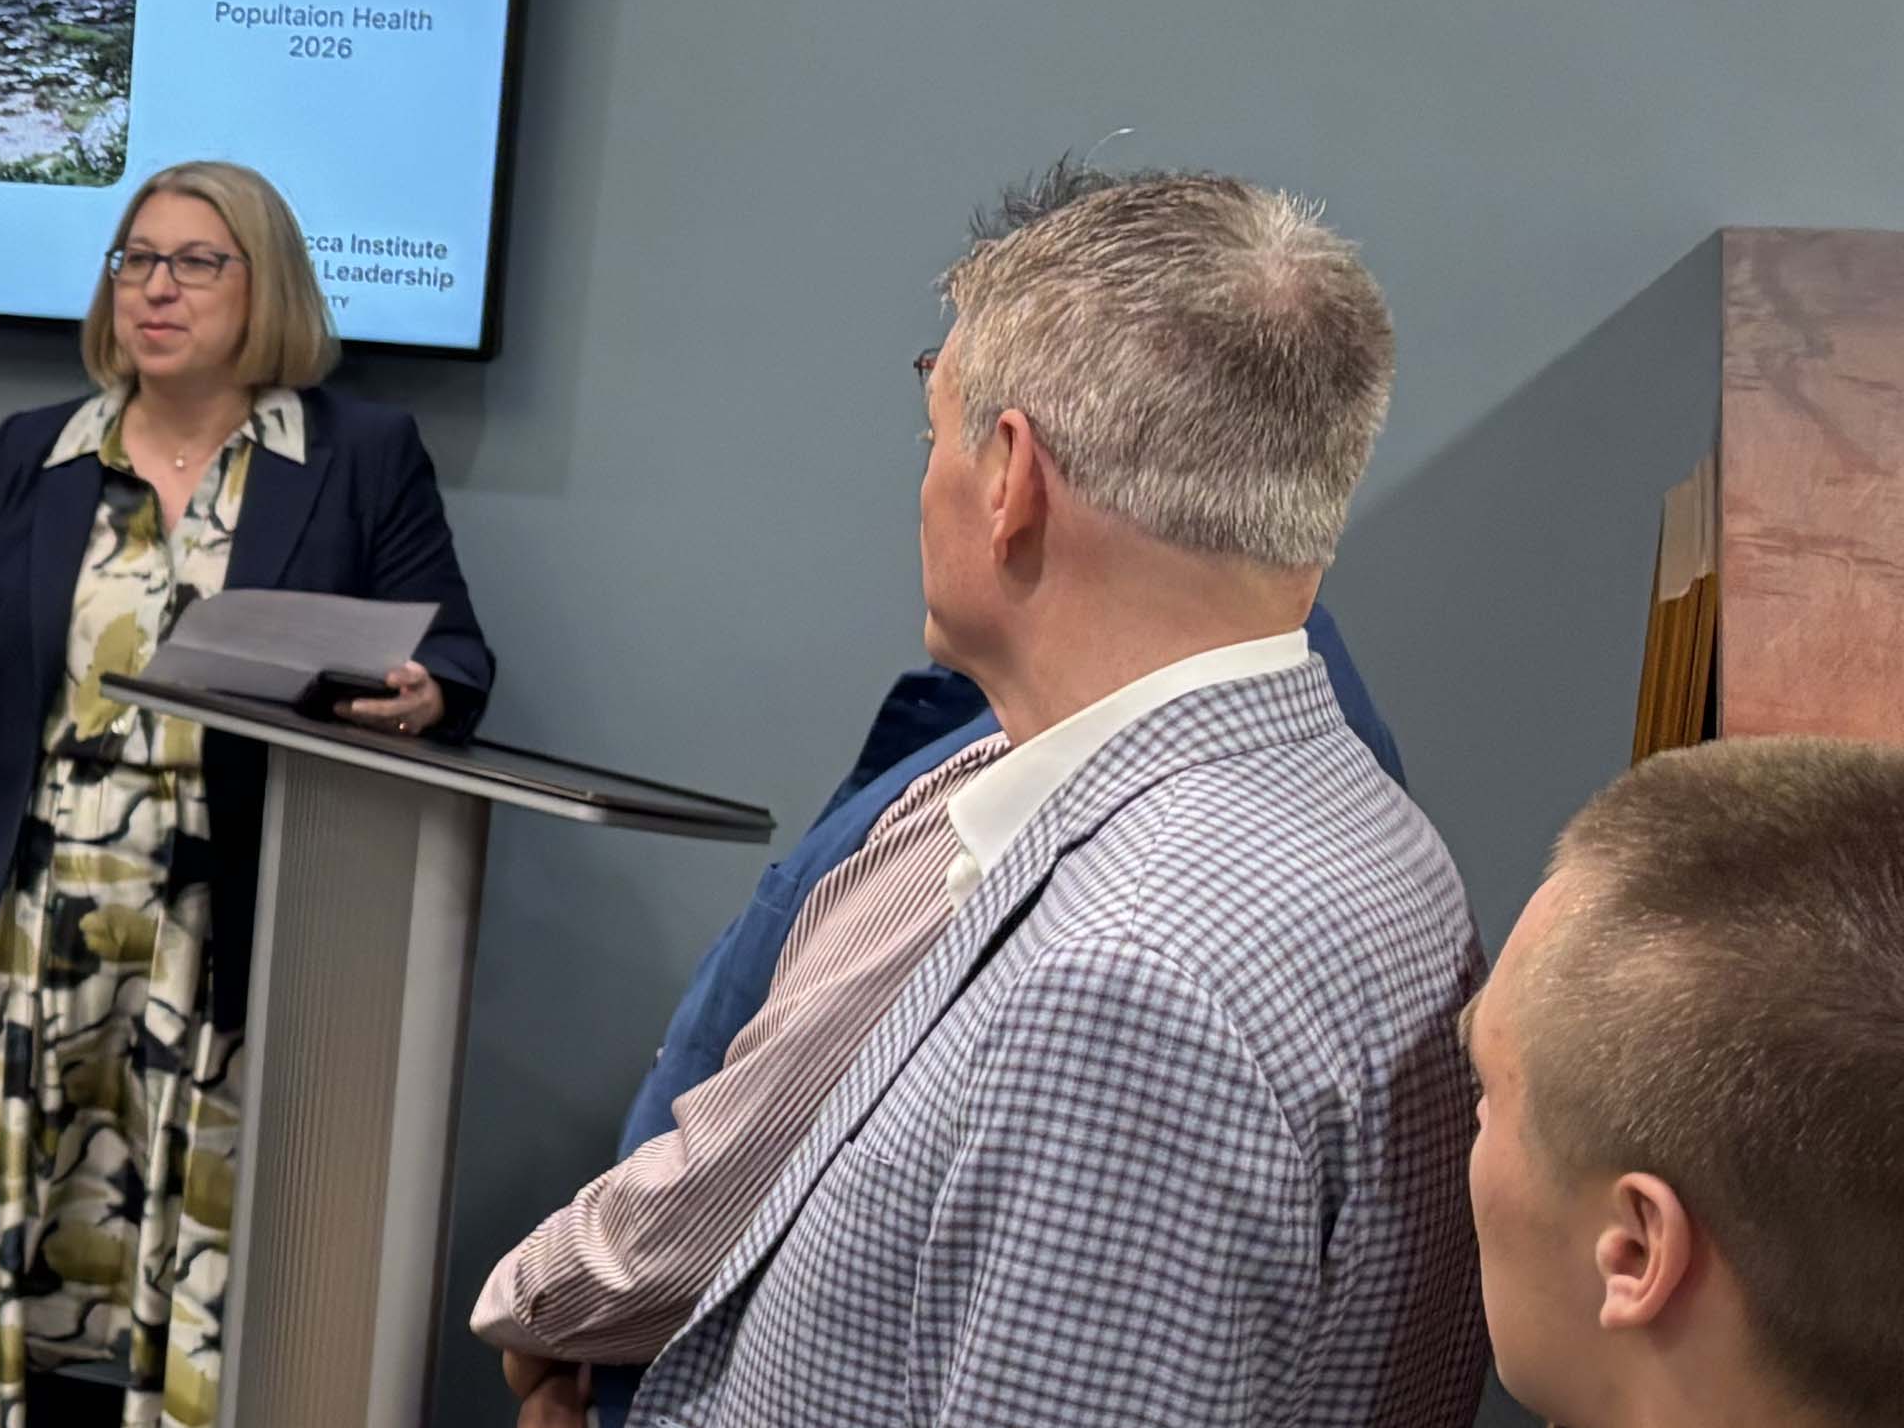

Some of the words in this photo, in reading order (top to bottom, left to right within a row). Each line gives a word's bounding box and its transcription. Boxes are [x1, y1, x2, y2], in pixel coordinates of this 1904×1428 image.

[215, 1, 344, 28] Popultaion
[352, 7, 433, 31] Health
[289, 35, 353, 59] 2026
[350, 233, 448, 260] Institute
[324, 260, 454, 292] Leadership
